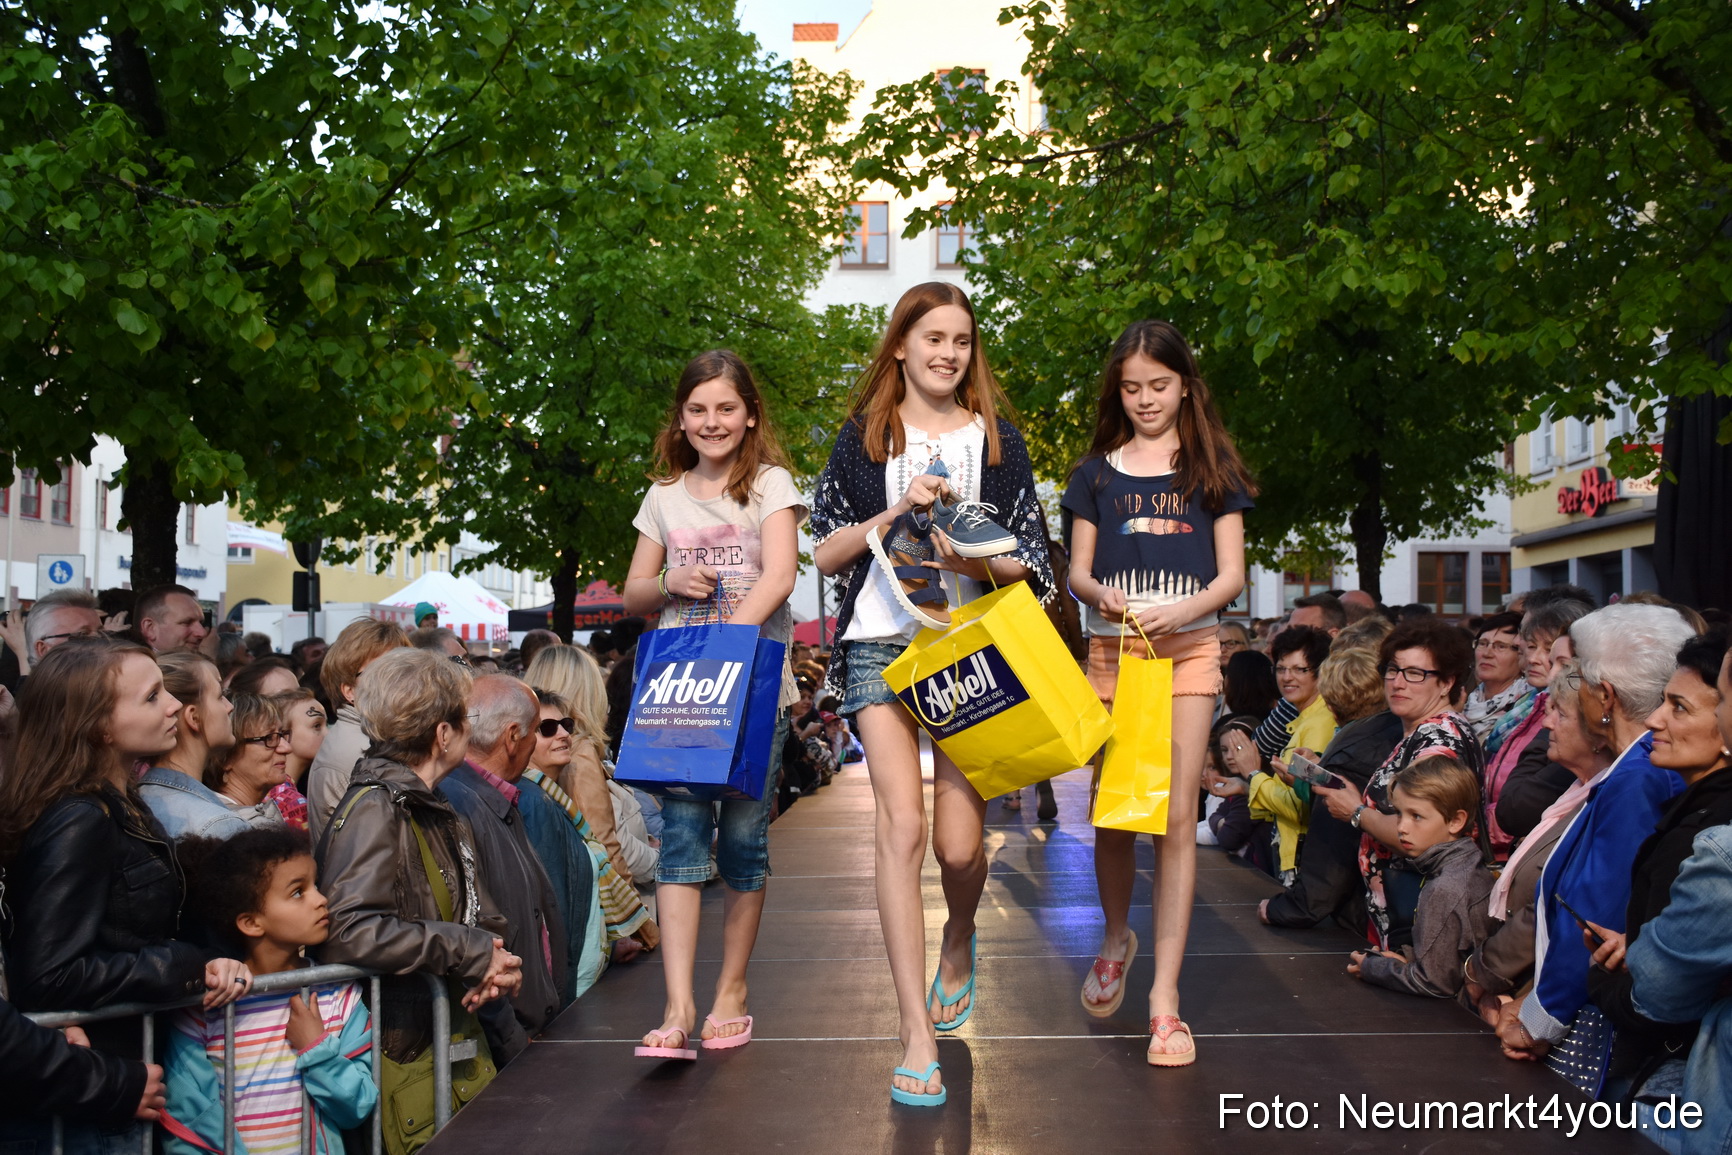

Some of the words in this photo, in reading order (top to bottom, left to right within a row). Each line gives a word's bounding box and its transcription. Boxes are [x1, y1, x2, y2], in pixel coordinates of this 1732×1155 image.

[1557, 487, 1579, 514] Der
[678, 545, 744, 567] FREE
[638, 661, 744, 705] Arbell
[925, 650, 998, 719] Arbell
[976, 696, 992, 707] GUTE
[991, 688, 1005, 701] IDEE
[634, 717, 668, 726] Neumarkt
[673, 717, 721, 728] Kirchengasse
[723, 718, 732, 727] 1c
[642, 707, 660, 715] GUTE
[691, 707, 710, 715] GUTE
[711, 707, 728, 715] IDEE
[941, 719, 967, 734] Neumarkt
[969, 700, 1007, 721] Kirchengasse
[1006, 695, 1015, 703] 1c
